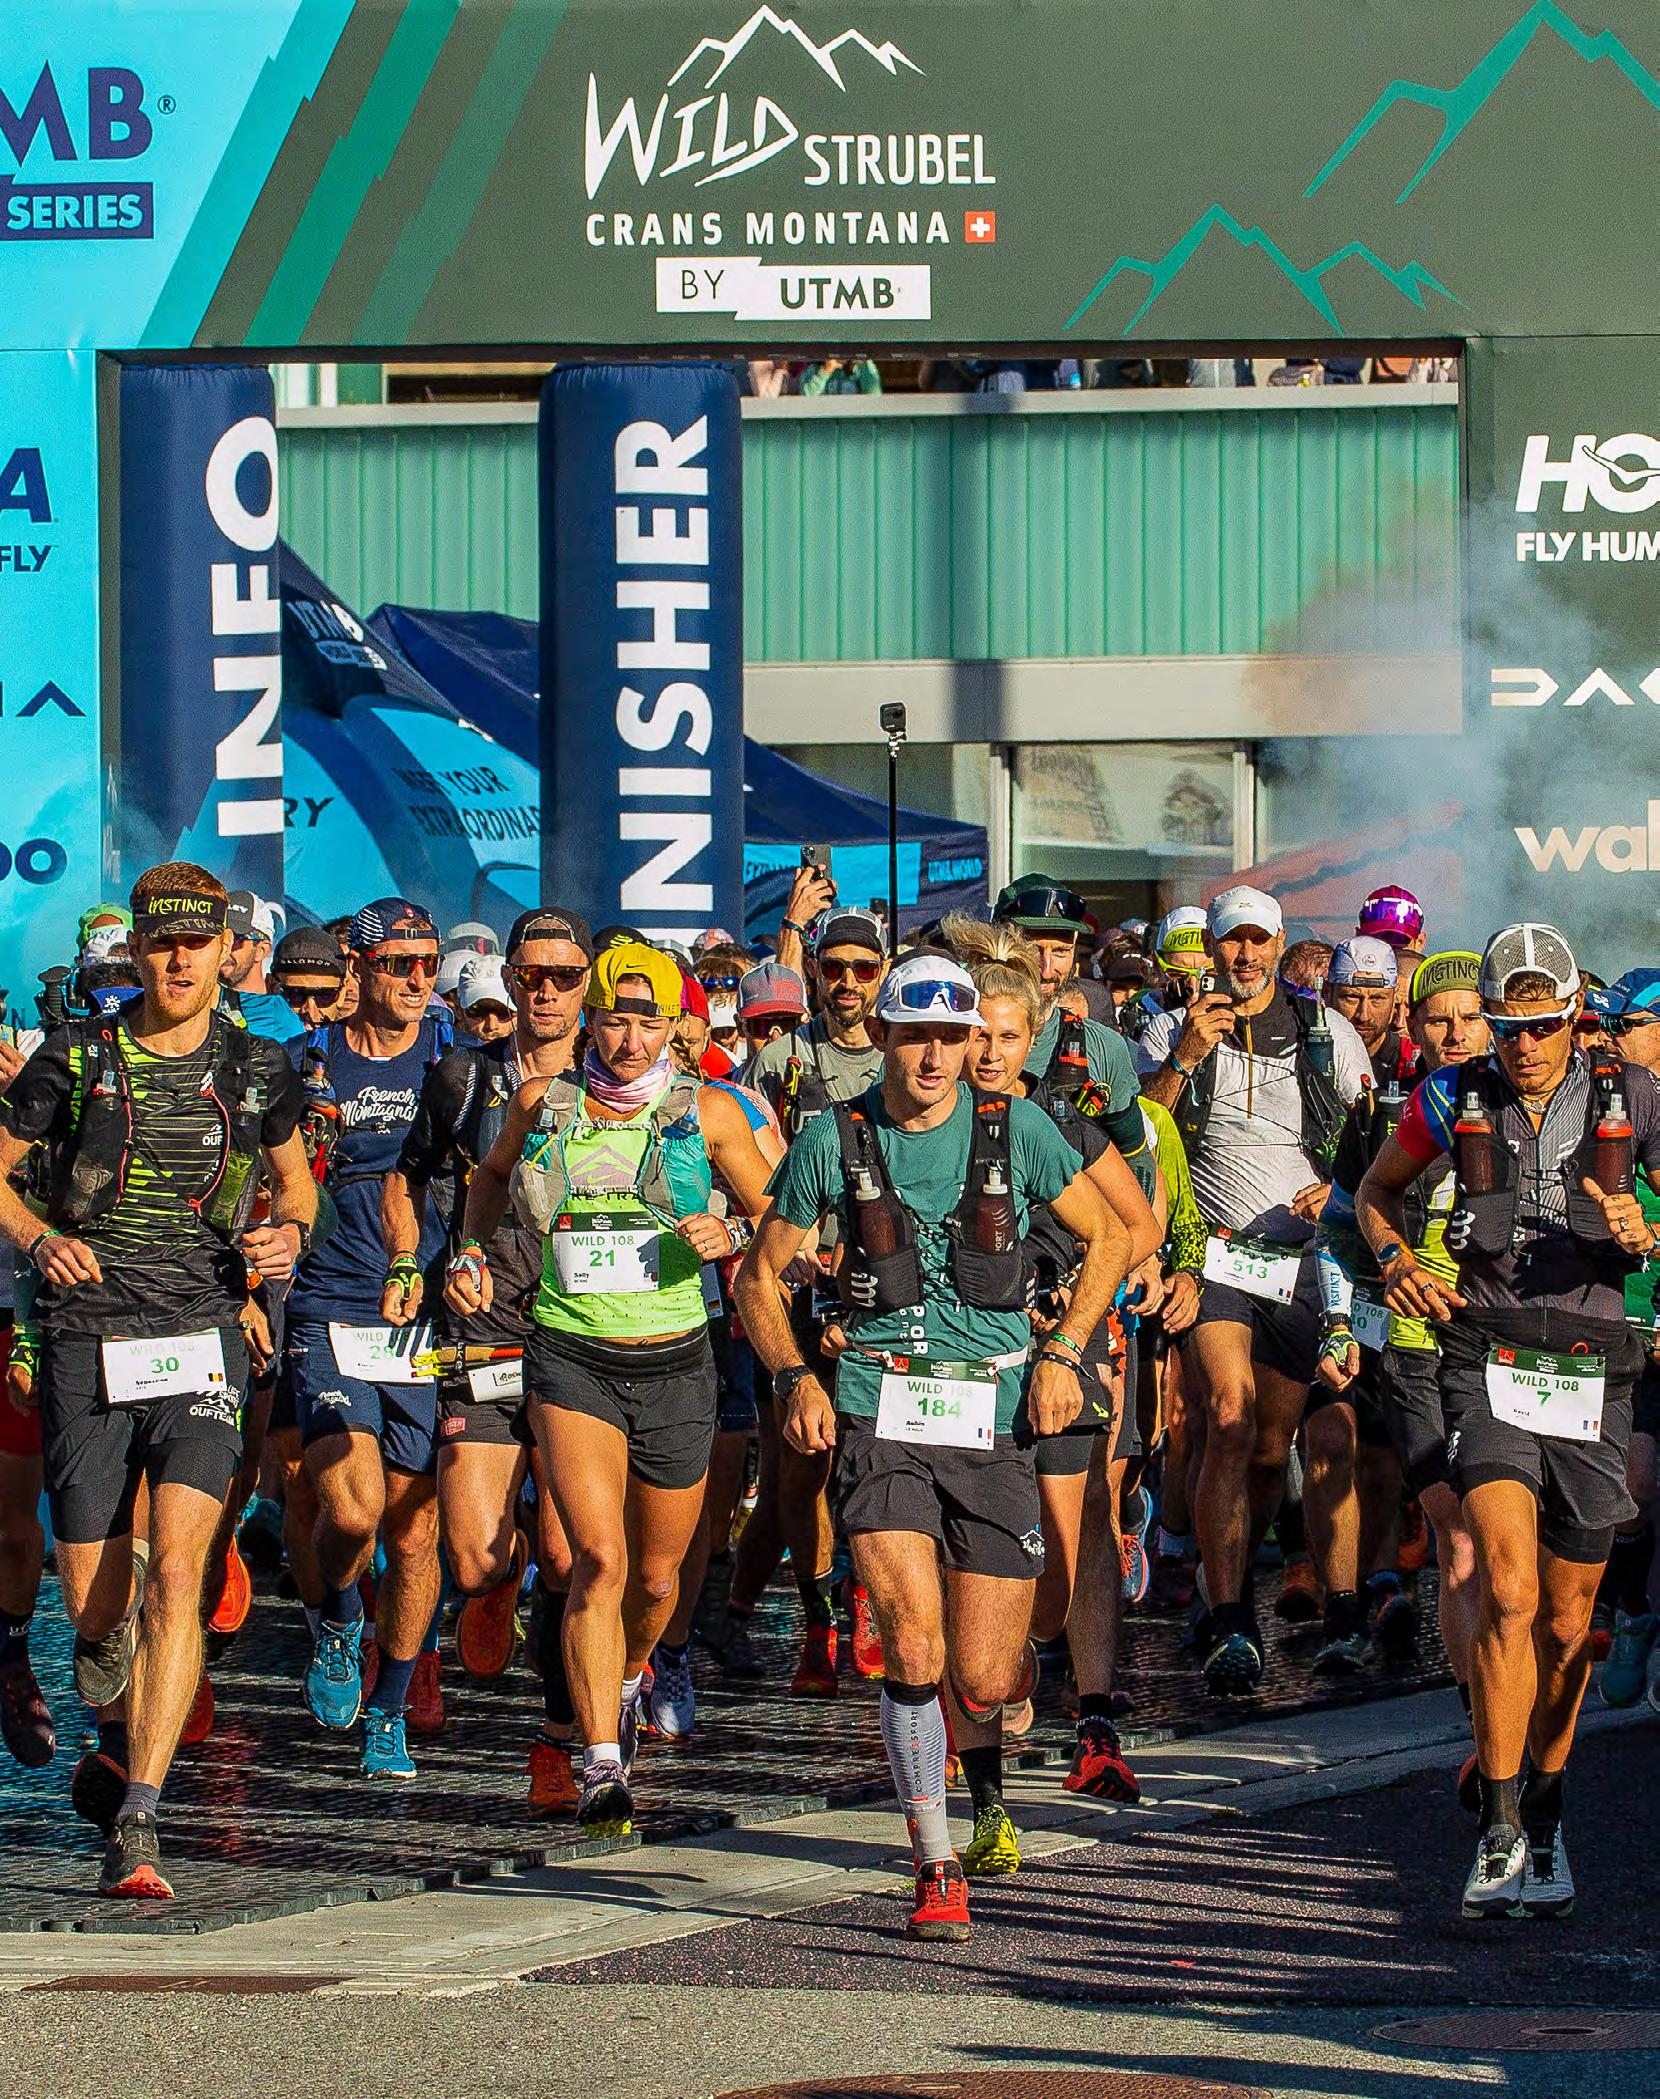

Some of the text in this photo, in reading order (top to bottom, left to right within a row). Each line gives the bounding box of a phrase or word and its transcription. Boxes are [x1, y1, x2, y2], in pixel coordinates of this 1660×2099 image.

[584, 71, 996, 200] WILD STRUBEL
[7, 194, 143, 230] SERIES
[585, 211, 950, 246] CRANS MONTANA
[680, 269, 725, 300] BY
[780, 277, 895, 309] UTMB
[0, 545, 52, 572] FLY
[1516, 530, 1577, 562] FLY
[204, 415, 284, 838] INFO
[437, 766, 509, 796] YOUR
[357, 1085, 417, 1108] French
[571, 1235, 635, 1247] WILD 108
[589, 1249, 615, 1268] 21
[1232, 1259, 1269, 1280] 513
[150, 1356, 181, 1375] 30
[906, 1381, 944, 1395] WILD
[1511, 1373, 1580, 1392] WILD 108
[917, 1397, 962, 1418] 184
[1537, 1390, 1552, 1407] 7
[910, 1710, 924, 1793] COMPRESSPORT
